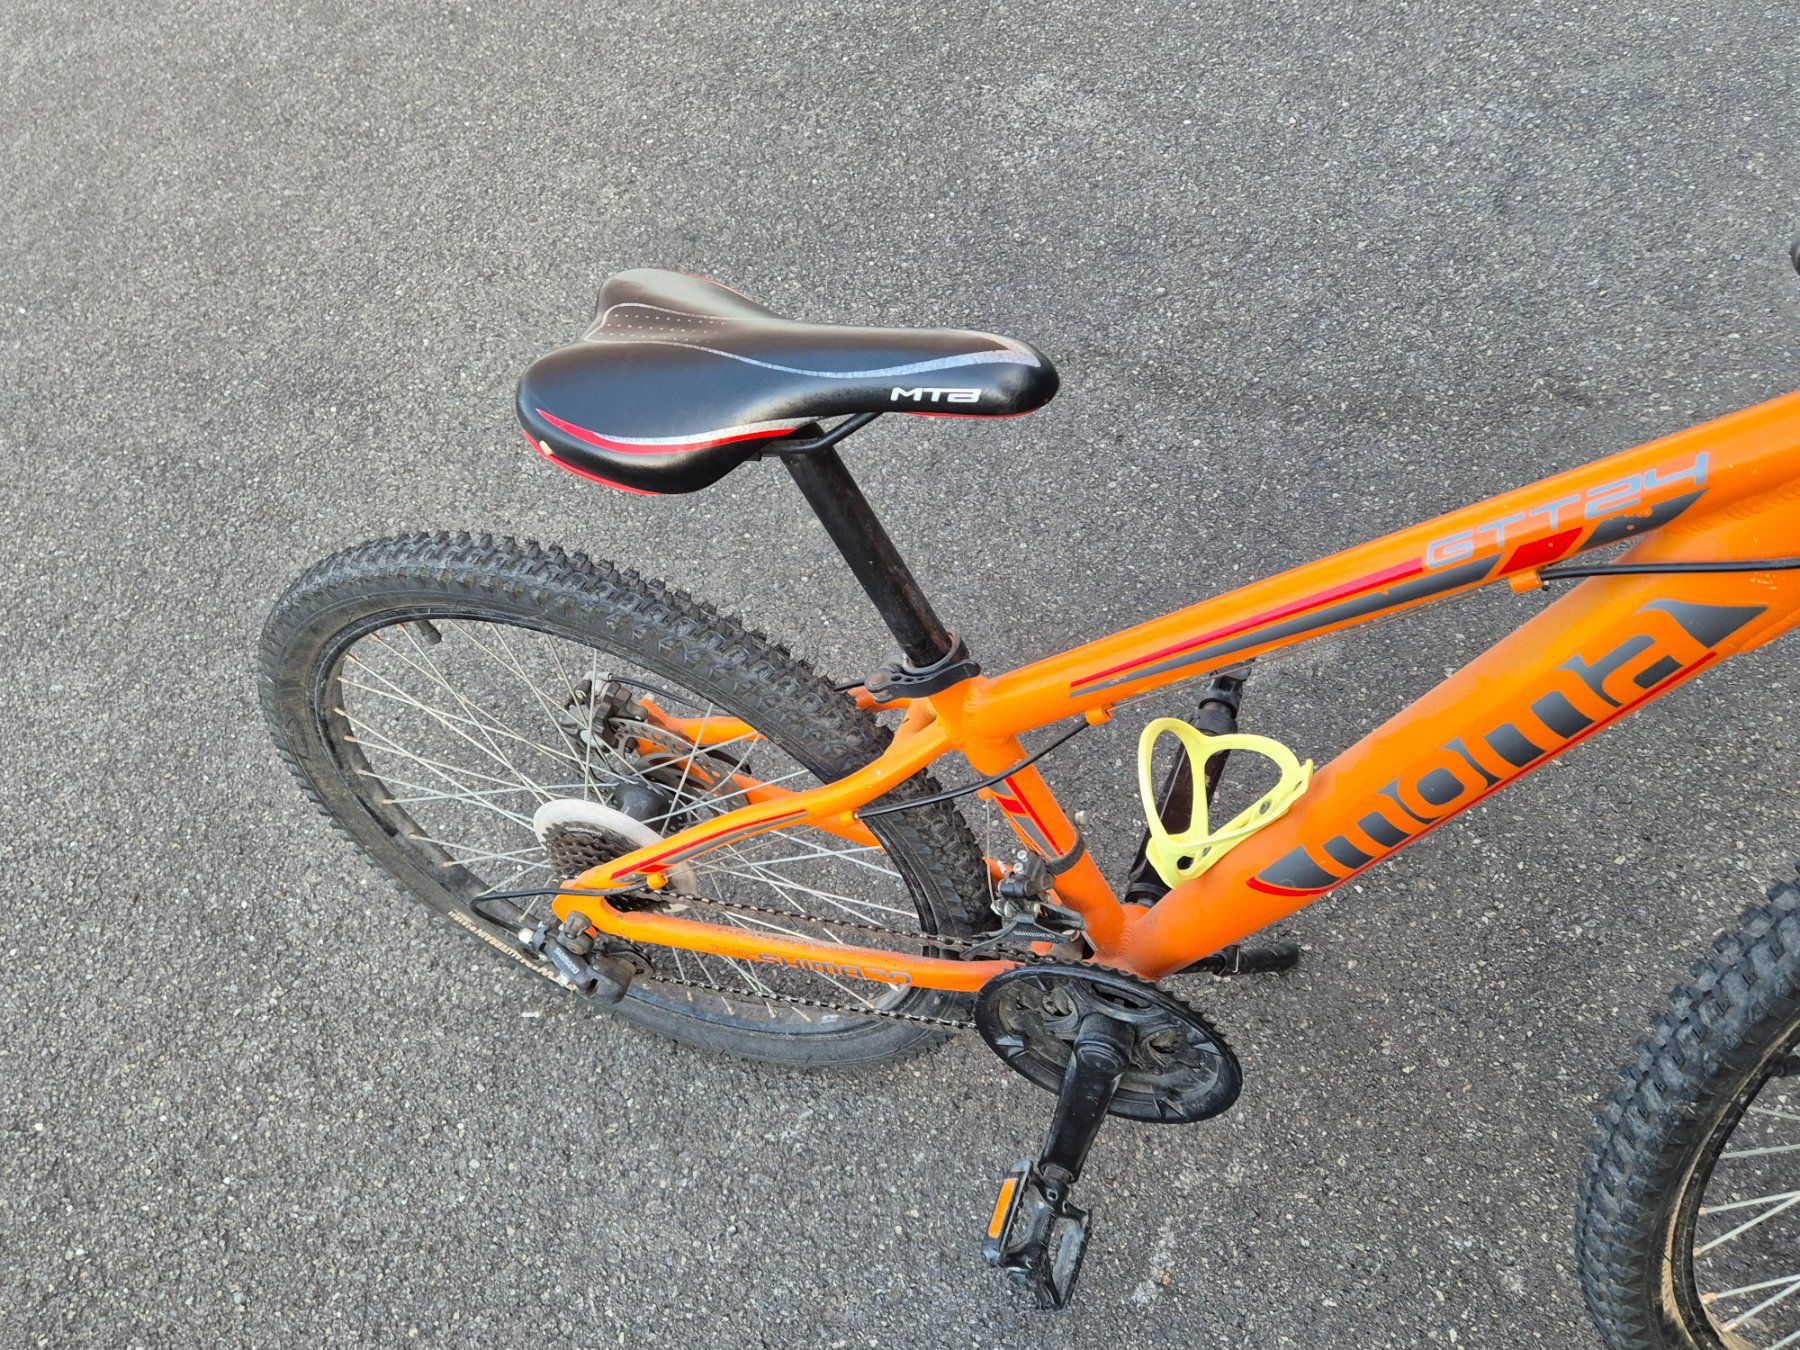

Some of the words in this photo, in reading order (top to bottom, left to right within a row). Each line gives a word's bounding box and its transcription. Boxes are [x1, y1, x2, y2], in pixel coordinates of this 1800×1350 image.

[890, 387, 982, 403] MTB
[1290, 602, 1725, 885] moma
[1012, 930, 1056, 940] SHIMANO
[553, 947, 580, 974] SHIMANO
